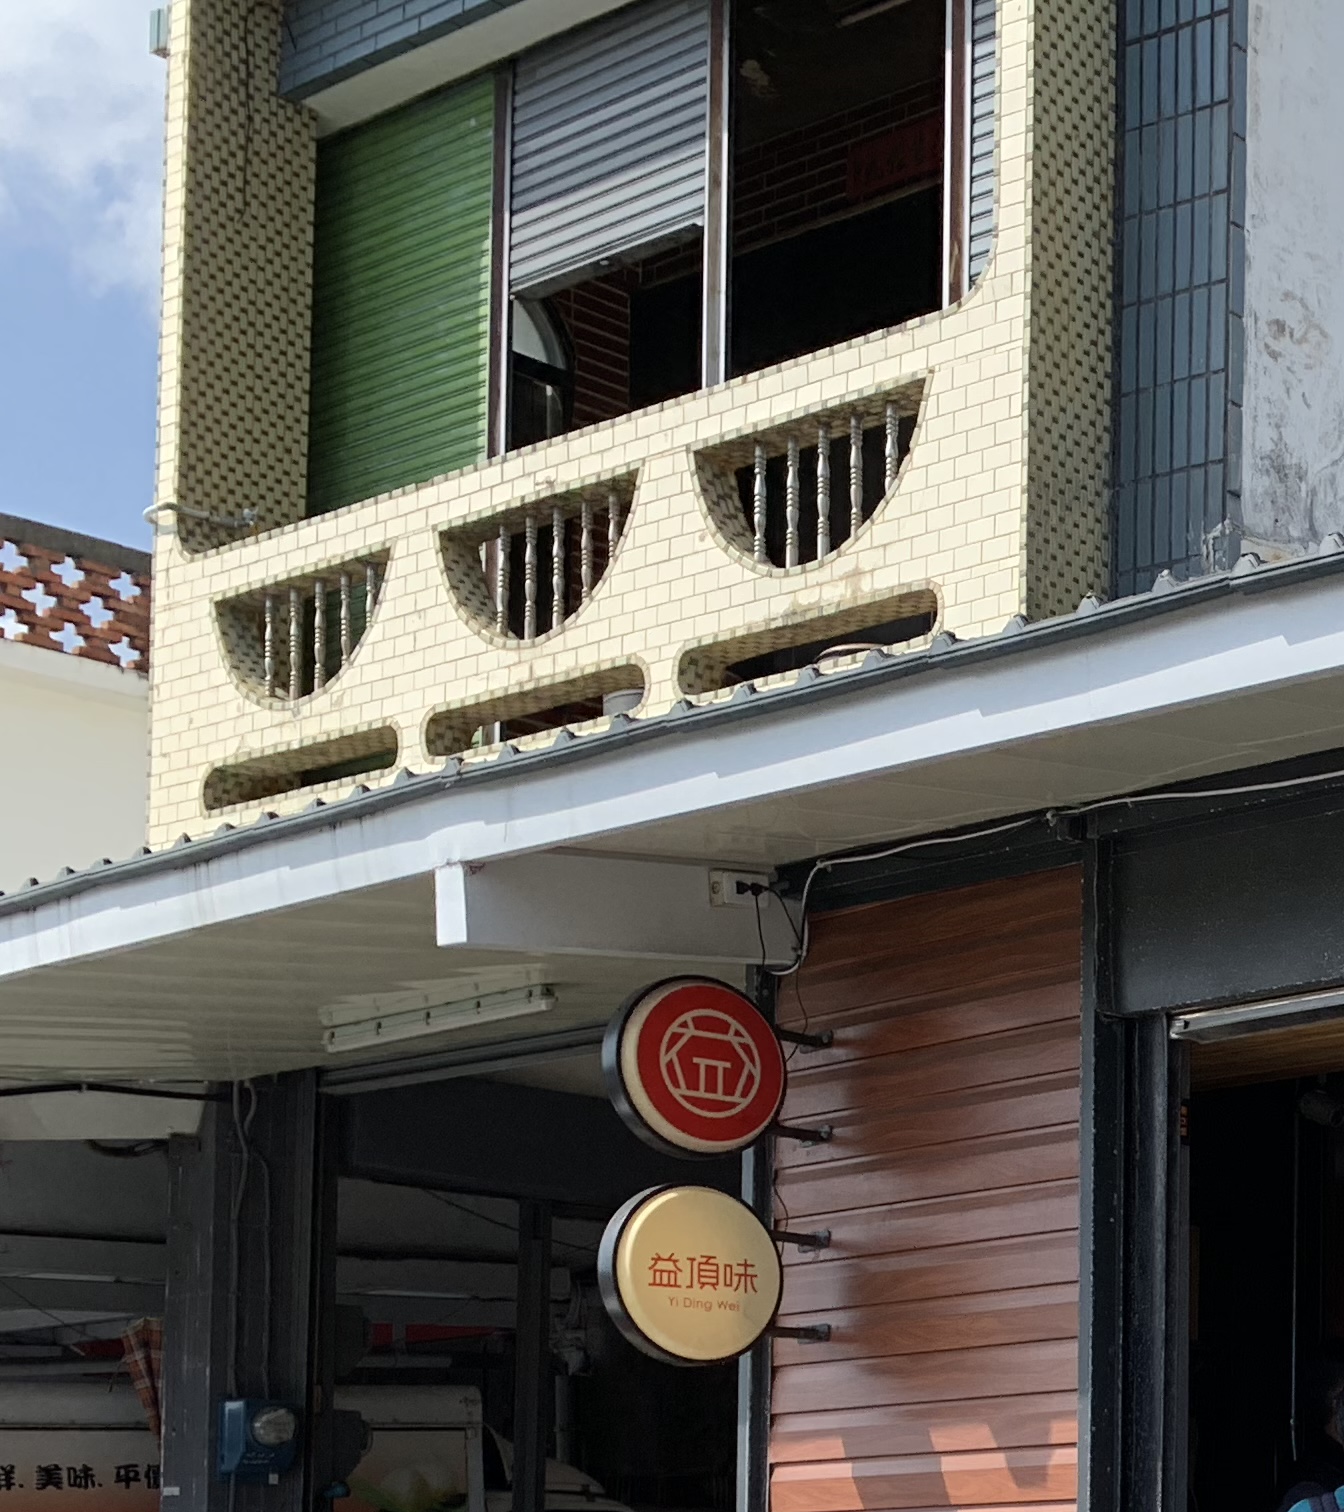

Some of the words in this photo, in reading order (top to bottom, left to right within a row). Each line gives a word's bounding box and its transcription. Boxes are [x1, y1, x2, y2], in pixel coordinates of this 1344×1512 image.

[648, 1252, 758, 1294] 益頂味
[668, 1296, 679, 1307] Yi
[683, 1297, 713, 1312] Ding
[717, 1300, 740, 1312] Wei
